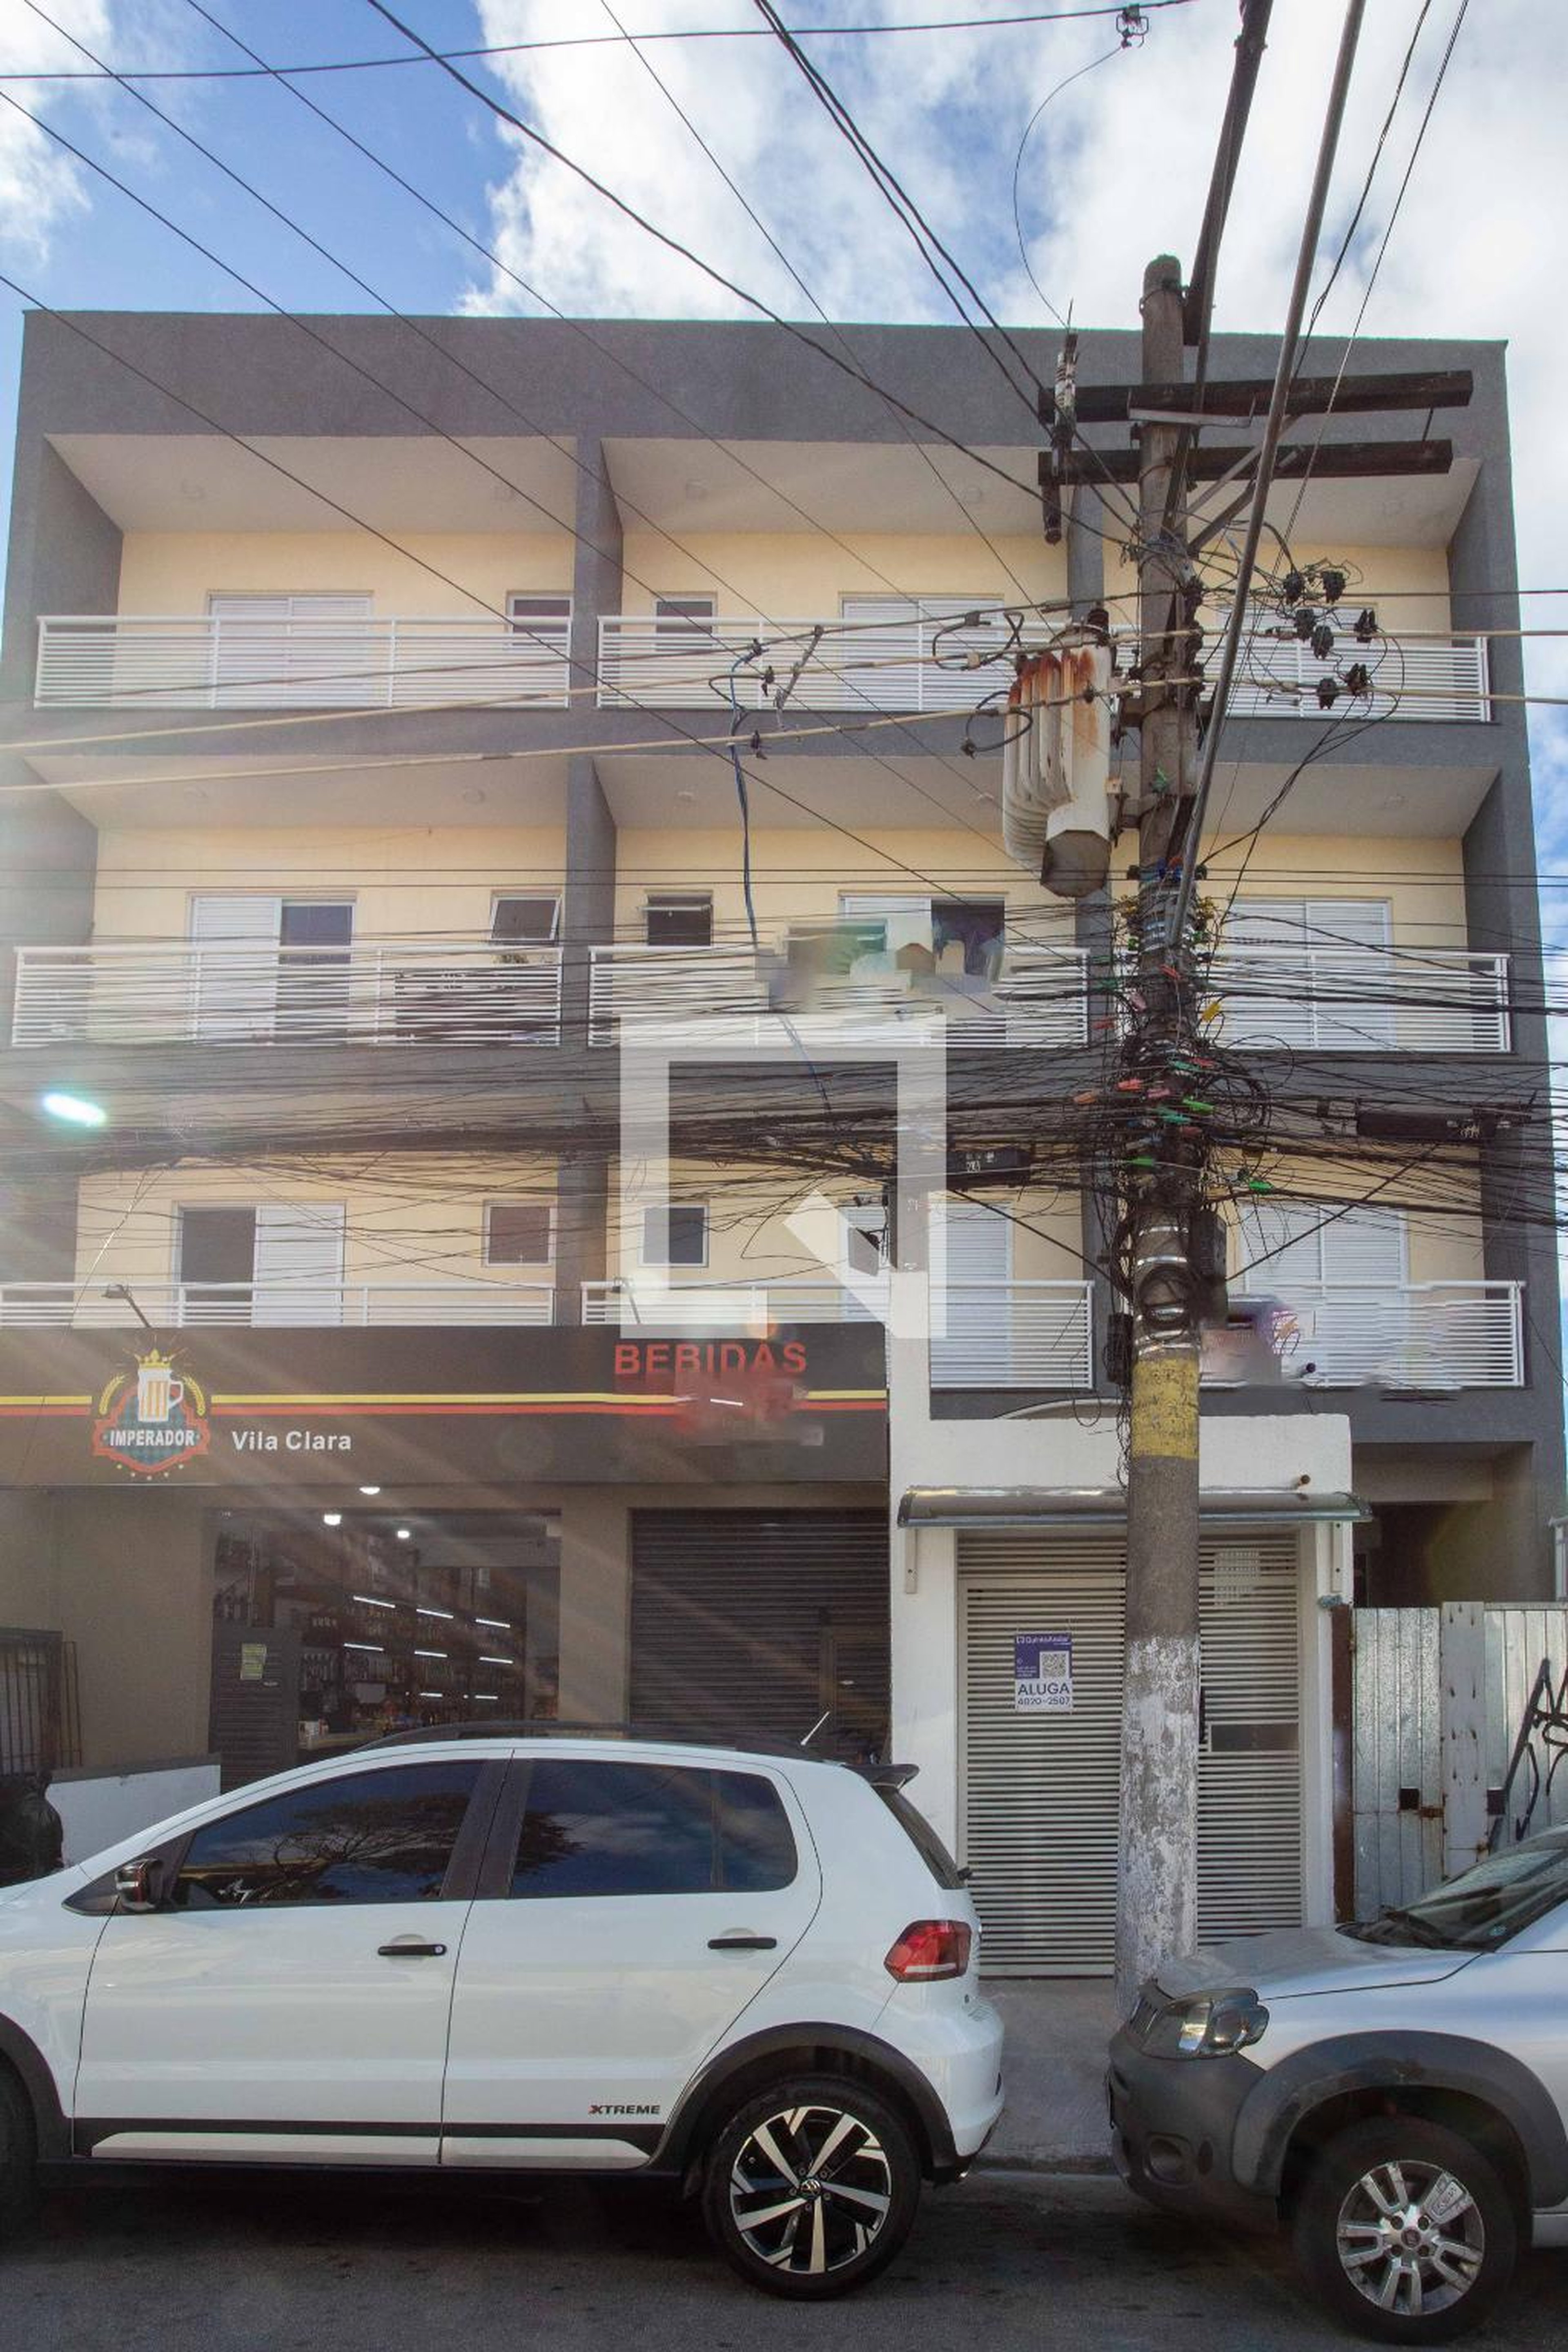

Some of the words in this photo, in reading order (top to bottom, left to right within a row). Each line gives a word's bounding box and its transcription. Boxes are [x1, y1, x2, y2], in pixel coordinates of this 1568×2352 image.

[615, 1342, 807, 1374] BEBIDAS
[110, 1430, 195, 1446] IMPERADOR
[232, 1431, 278, 1450] Vila
[285, 1431, 352, 1450] Clara
[1018, 1683, 1069, 1695] ALUGA
[589, 2105, 660, 2114] XTREME
